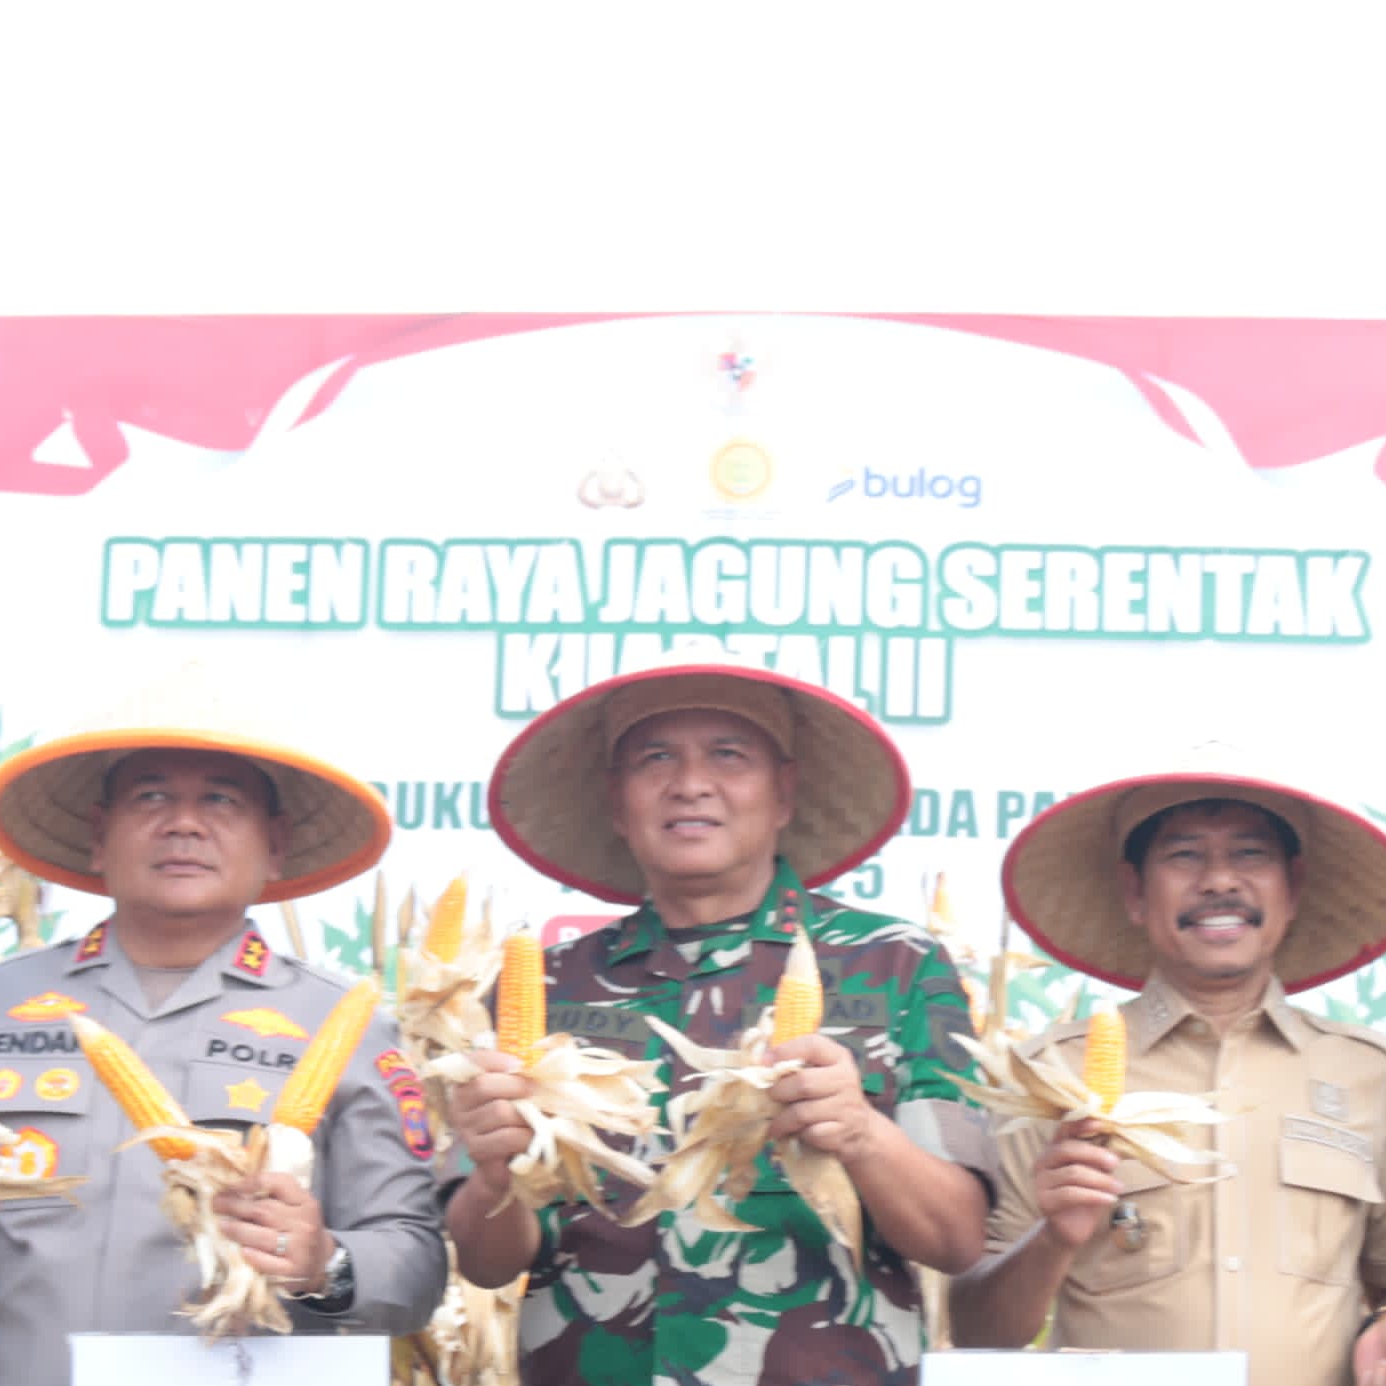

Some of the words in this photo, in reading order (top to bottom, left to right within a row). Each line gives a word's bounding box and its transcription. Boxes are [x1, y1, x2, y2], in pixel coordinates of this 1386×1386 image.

[863, 467, 982, 508] bulog
[103, 538, 368, 627] PANEN
[378, 539, 581, 629] RAYA
[597, 538, 927, 636] JAGUNG
[941, 543, 1370, 642] SERENTAK
[206, 1039, 298, 1070] POLR
